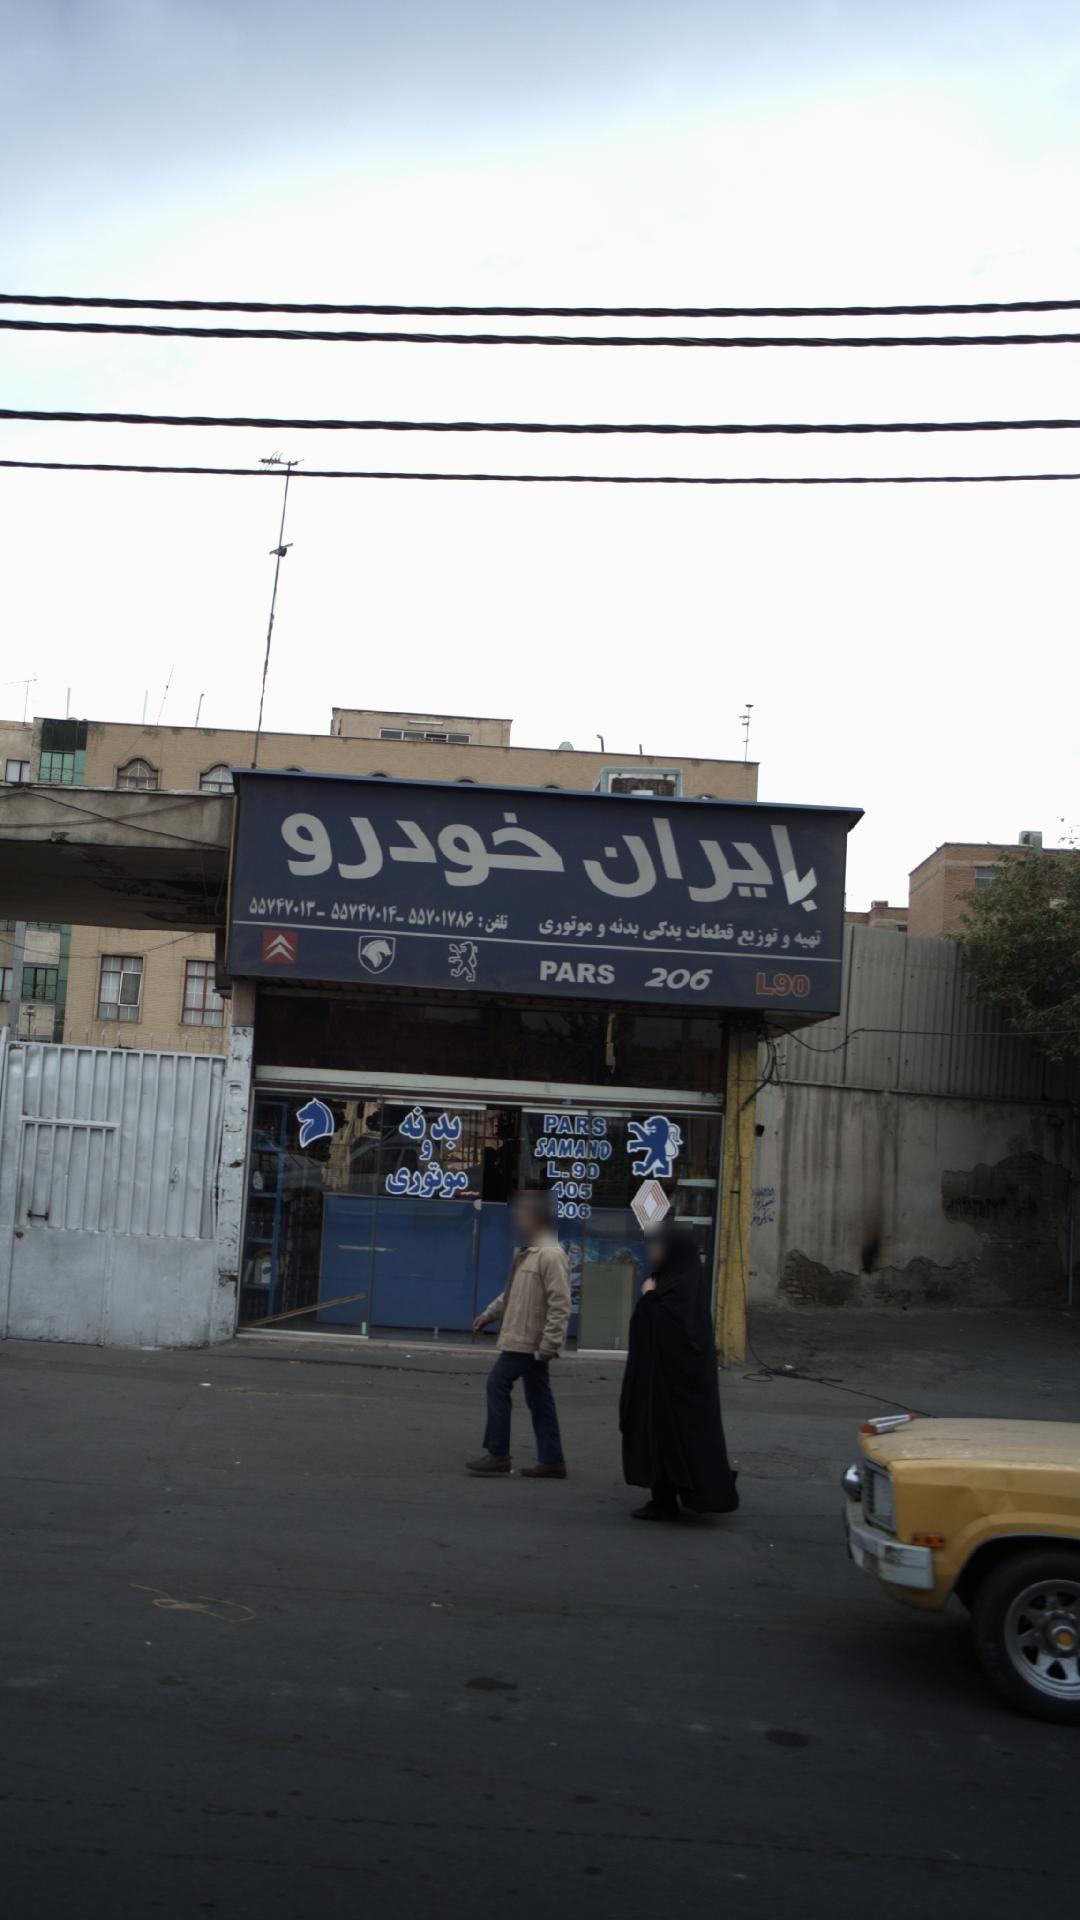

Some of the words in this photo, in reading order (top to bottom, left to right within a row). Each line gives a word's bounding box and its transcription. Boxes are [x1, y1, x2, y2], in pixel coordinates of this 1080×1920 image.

[281, 812, 565, 887] خودرو
[538, 915, 593, 937] موتوری
[597, 922, 606, 938] و
[609, 919, 639, 938] بدنه
[643, 921, 682, 942] یدکی
[685, 922, 734, 940] قطعات
[736, 927, 778, 947] توزیع
[781, 931, 790, 948] و
[794, 931, 821, 949] تهیه
[539, 960, 615, 984] PARS
[644, 968, 713, 990] 206
[755, 972, 811, 998] L90
[543, 1115, 608, 1136] PARS
[419, 1139, 433, 1161] و
[534, 1137, 613, 1160] SAMAND
[385, 1161, 469, 1198] موتوری
